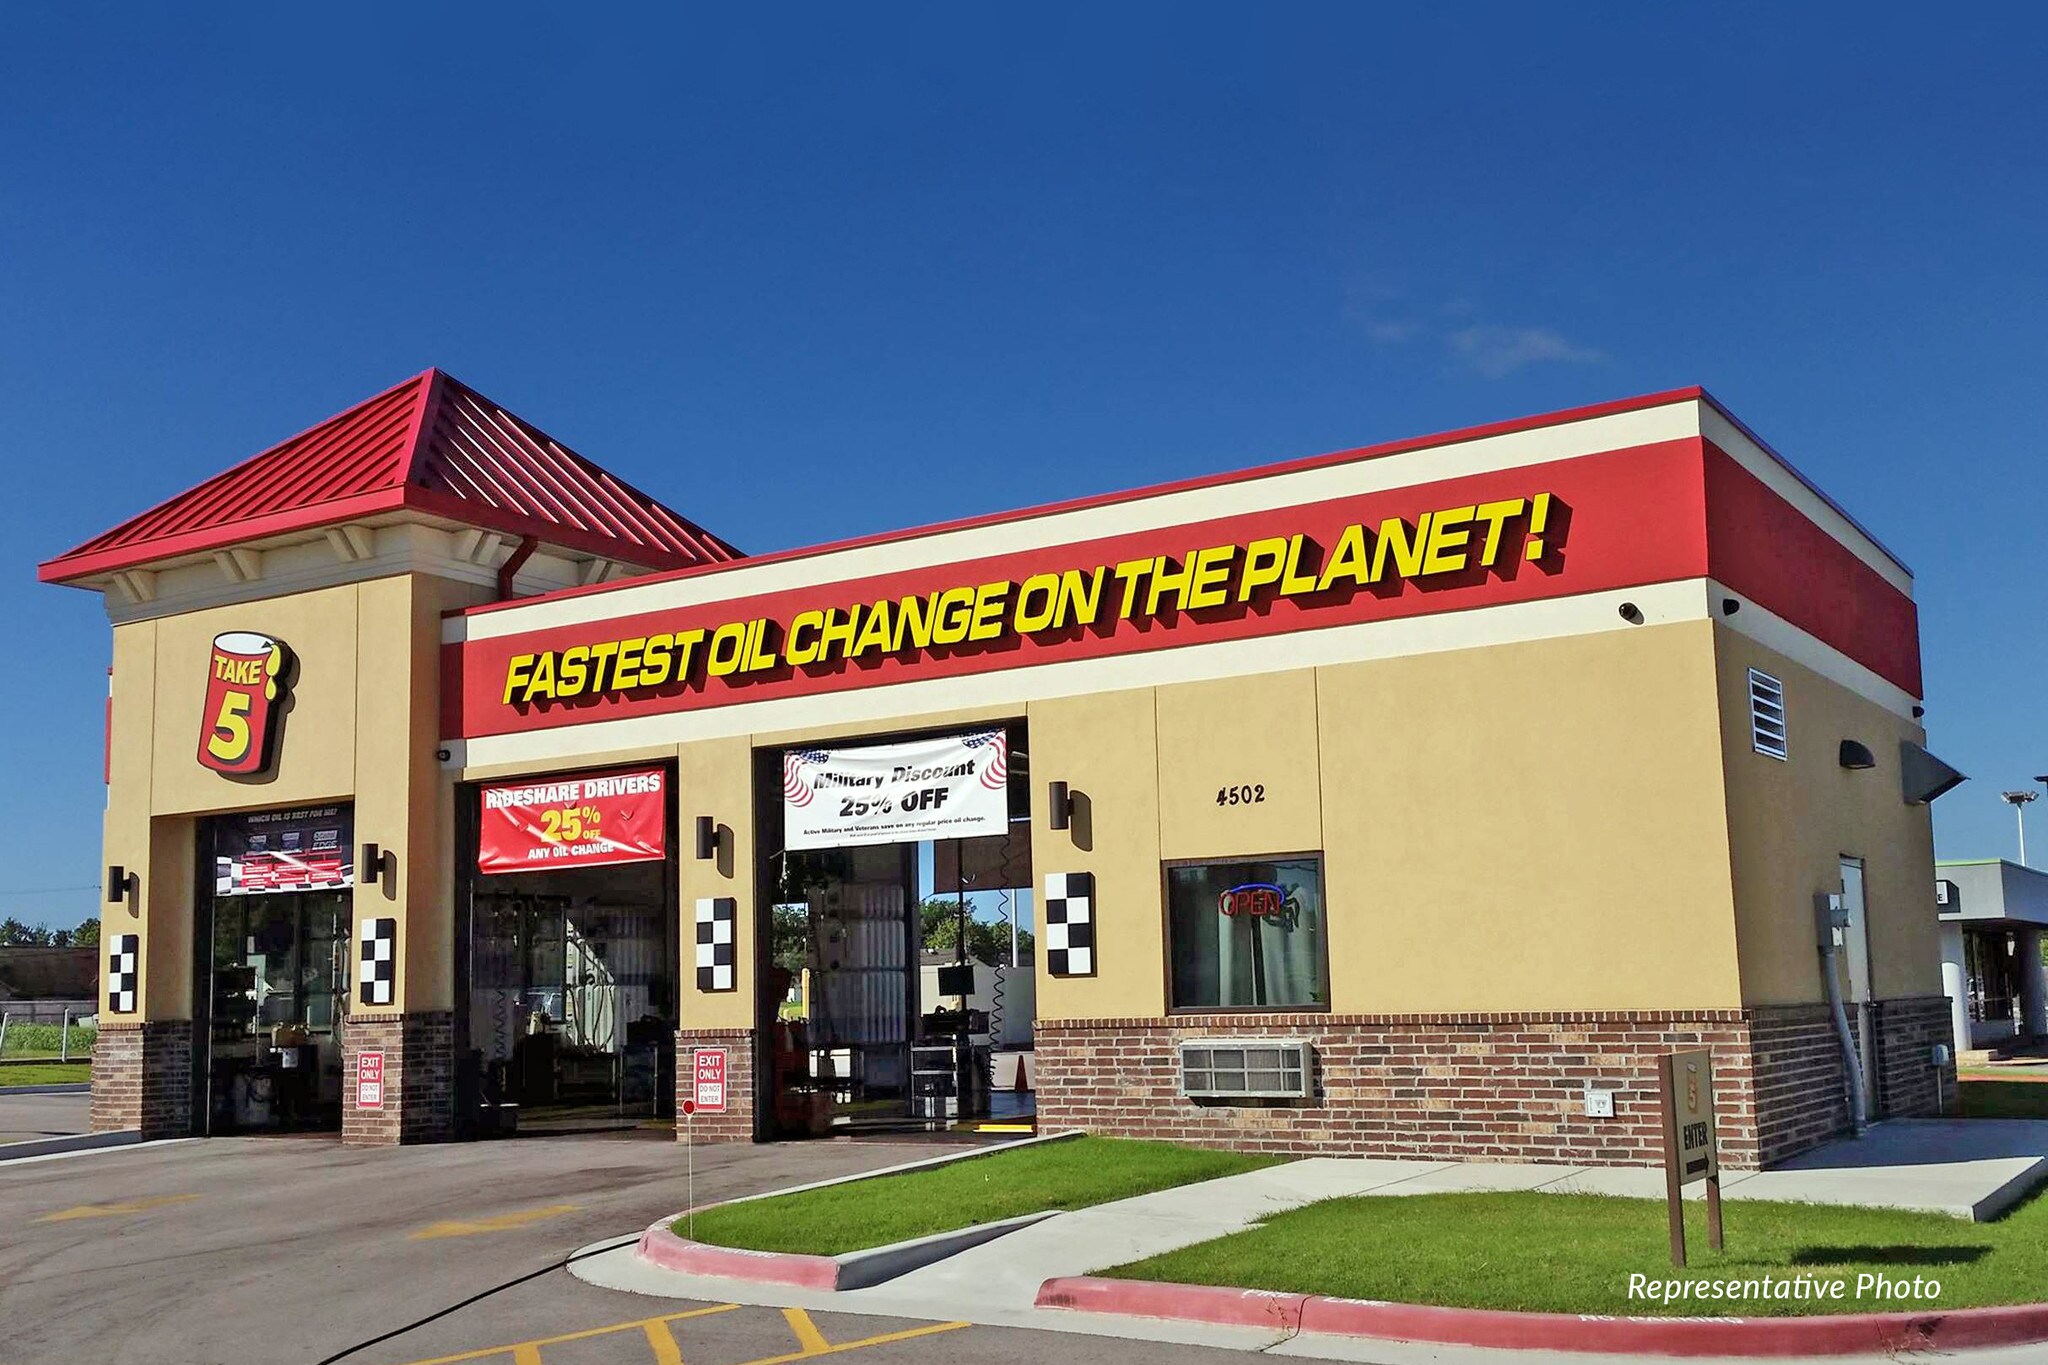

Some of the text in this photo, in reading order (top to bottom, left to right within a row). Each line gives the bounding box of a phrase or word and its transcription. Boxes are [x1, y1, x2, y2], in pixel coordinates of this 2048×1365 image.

[502, 492, 1552, 704] FASTEST OIL CHANGE ON THE PLANET!
[214, 654, 263, 685] TAKE
[207, 690, 250, 761] 5
[813, 758, 976, 790] Military Discount
[486, 773, 661, 810] RIDESHARE DRIVERS
[839, 787, 949, 817] 25% OFF
[1216, 784, 1265, 806] 4502
[540, 805, 601, 843] 25% OFF
[937, 818, 952, 826] price
[528, 843, 614, 860] ANY OIL CHANGE
[1218, 890, 1280, 917] OPEN
[361, 1057, 380, 1068] EXIT
[699, 1055, 721, 1067] EXIT
[360, 1069, 380, 1080] ONLY
[698, 1068, 722, 1080] ONLY
[362, 1093, 378, 1101] ENTER
[699, 1085, 720, 1093] DO NOT
[1683, 1121, 1709, 1150] ENTER
